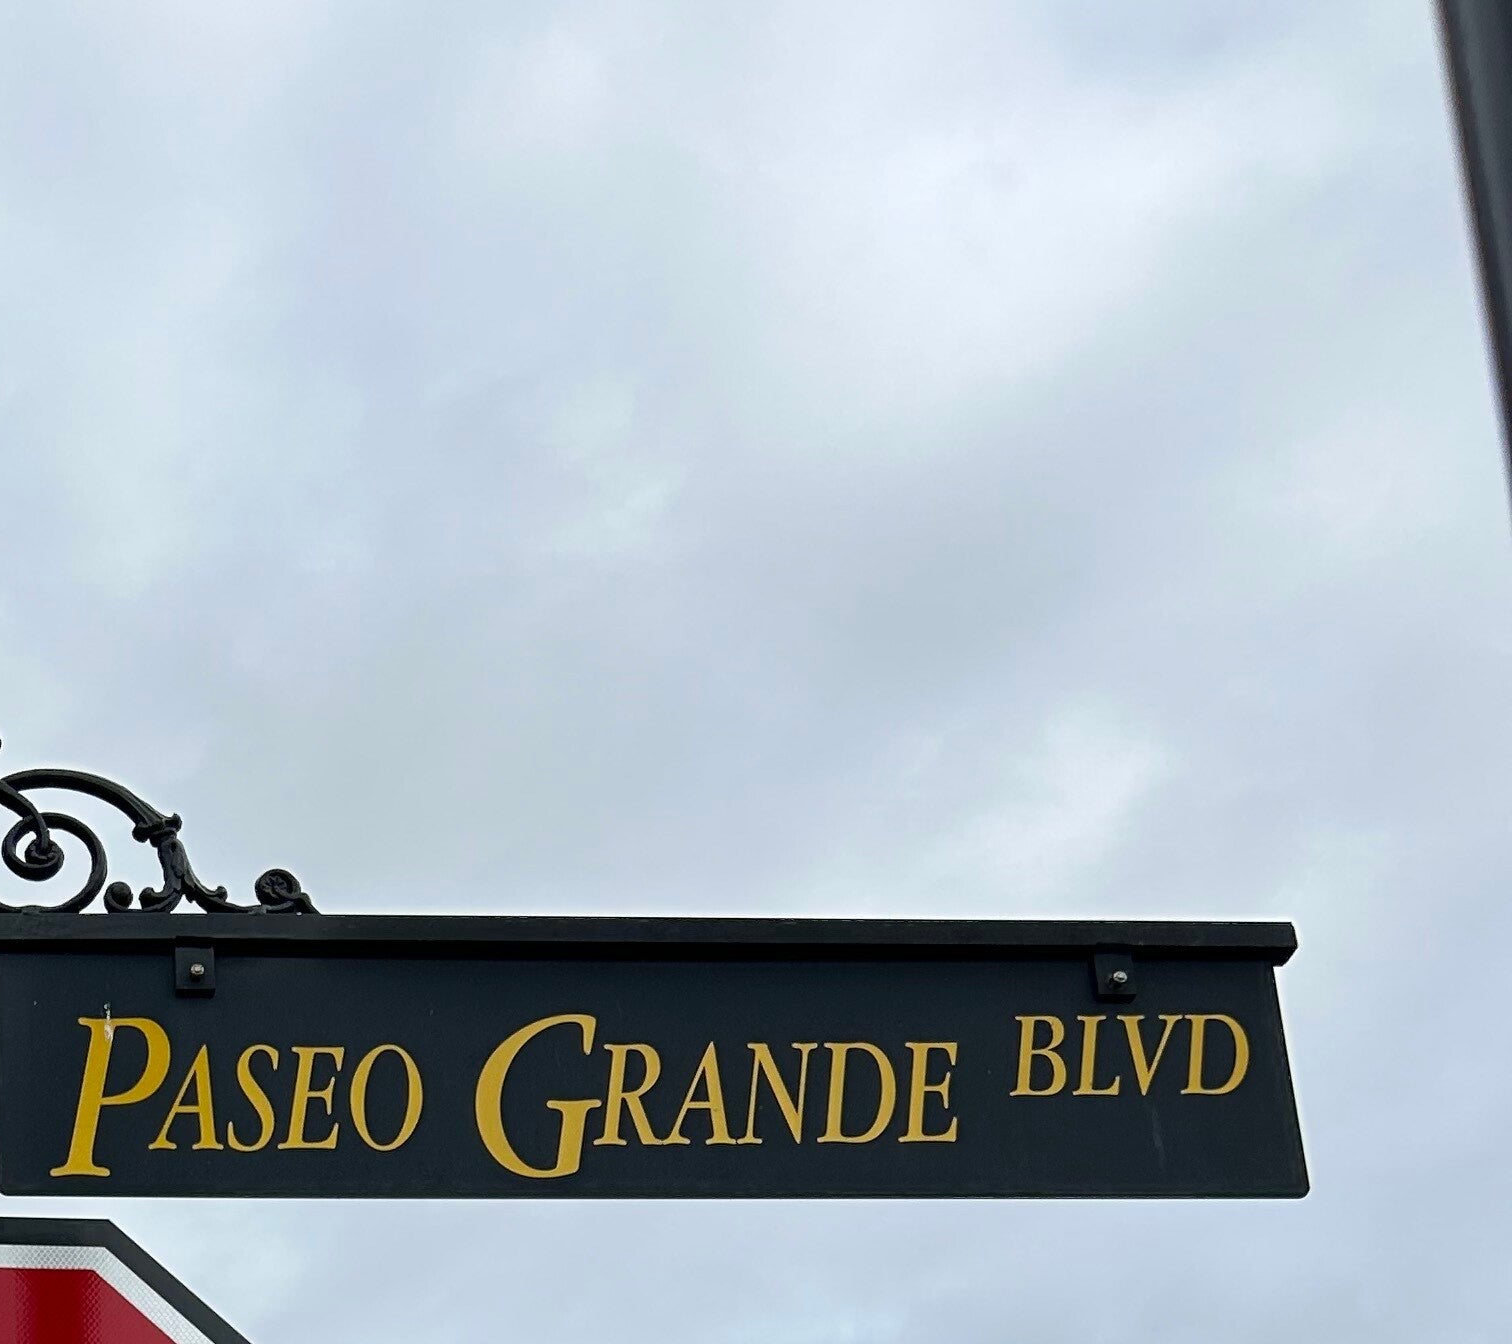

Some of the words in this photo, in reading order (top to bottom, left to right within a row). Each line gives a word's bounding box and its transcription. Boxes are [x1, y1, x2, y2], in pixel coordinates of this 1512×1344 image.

[50, 1014, 425, 1177] PASEO
[474, 1013, 958, 1178] GRANDE
[1009, 1013, 1251, 1096] BLVD
